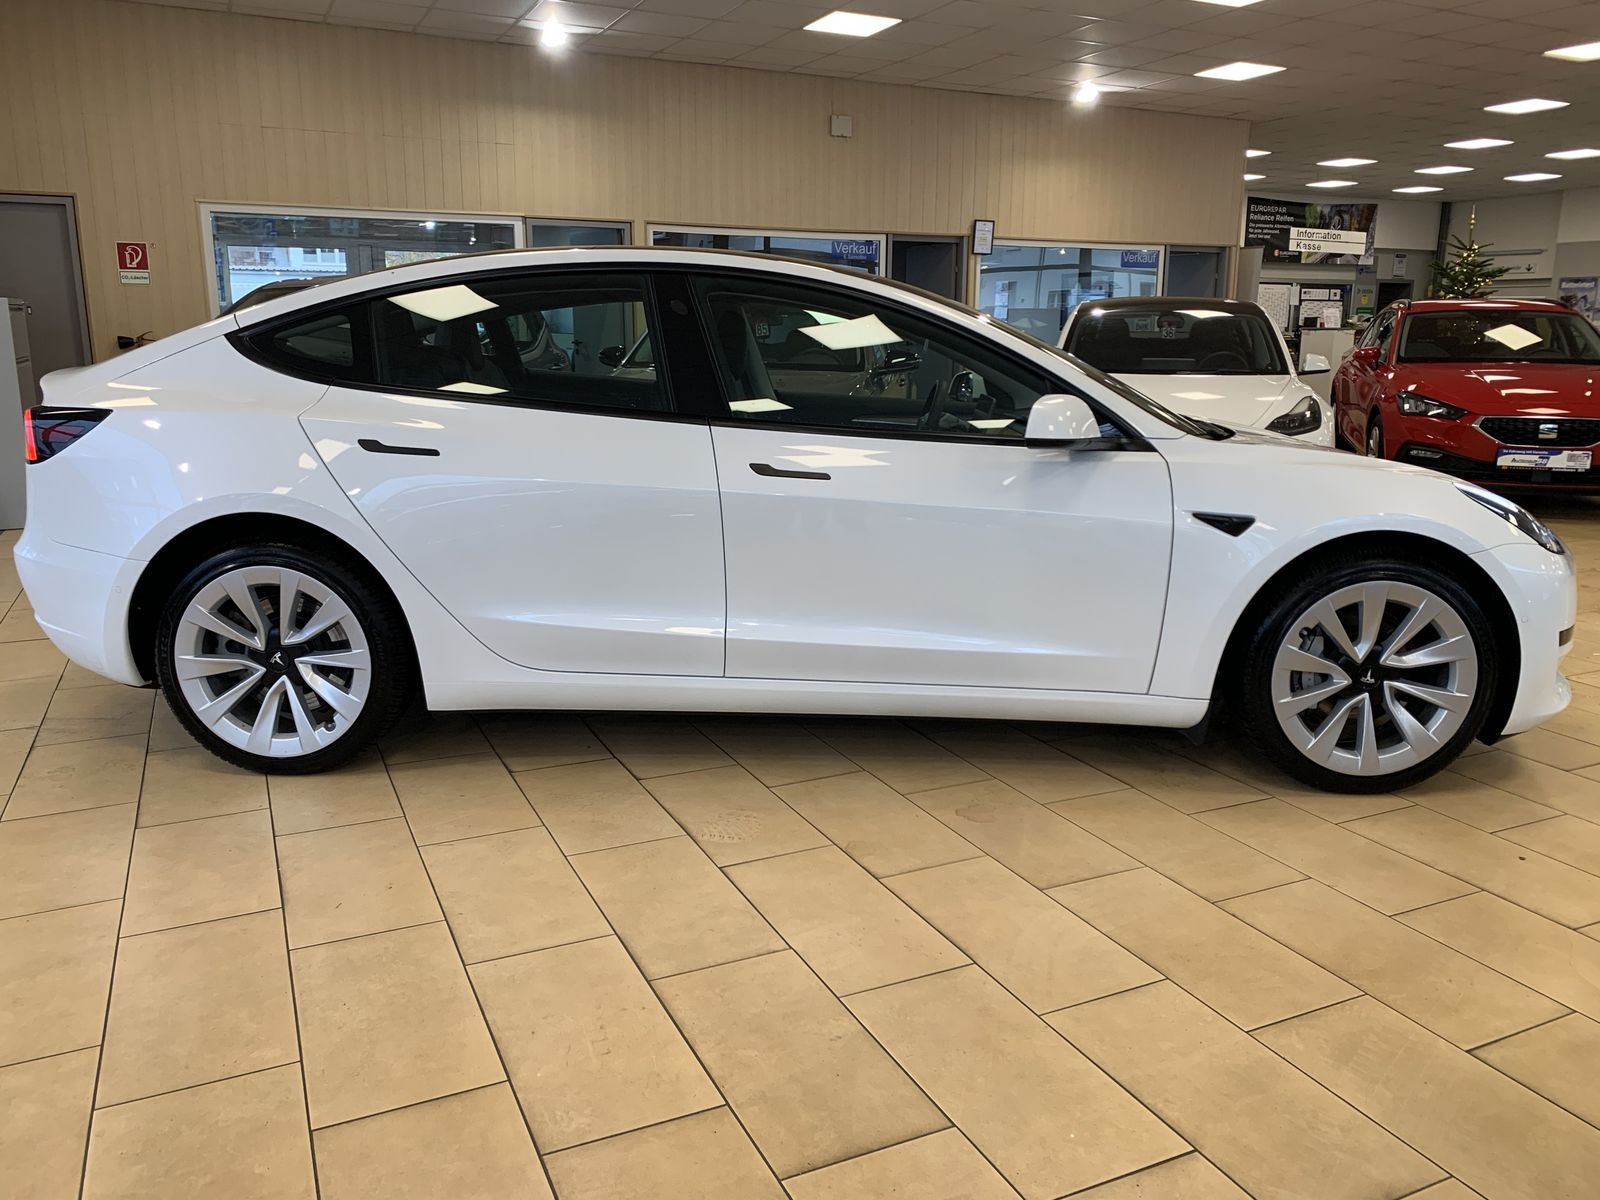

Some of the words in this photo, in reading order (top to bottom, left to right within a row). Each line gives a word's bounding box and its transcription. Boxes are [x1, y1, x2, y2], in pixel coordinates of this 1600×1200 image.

[1250, 205, 1287, 213] EUROREPAR
[1250, 213, 1275, 222] Reliance
[1275, 214, 1295, 222] Reifen
[1297, 230, 1341, 240] Information
[834, 242, 876, 254] Verkauf
[1296, 242, 1321, 250] Kasse
[1124, 252, 1156, 262] Verkauf
